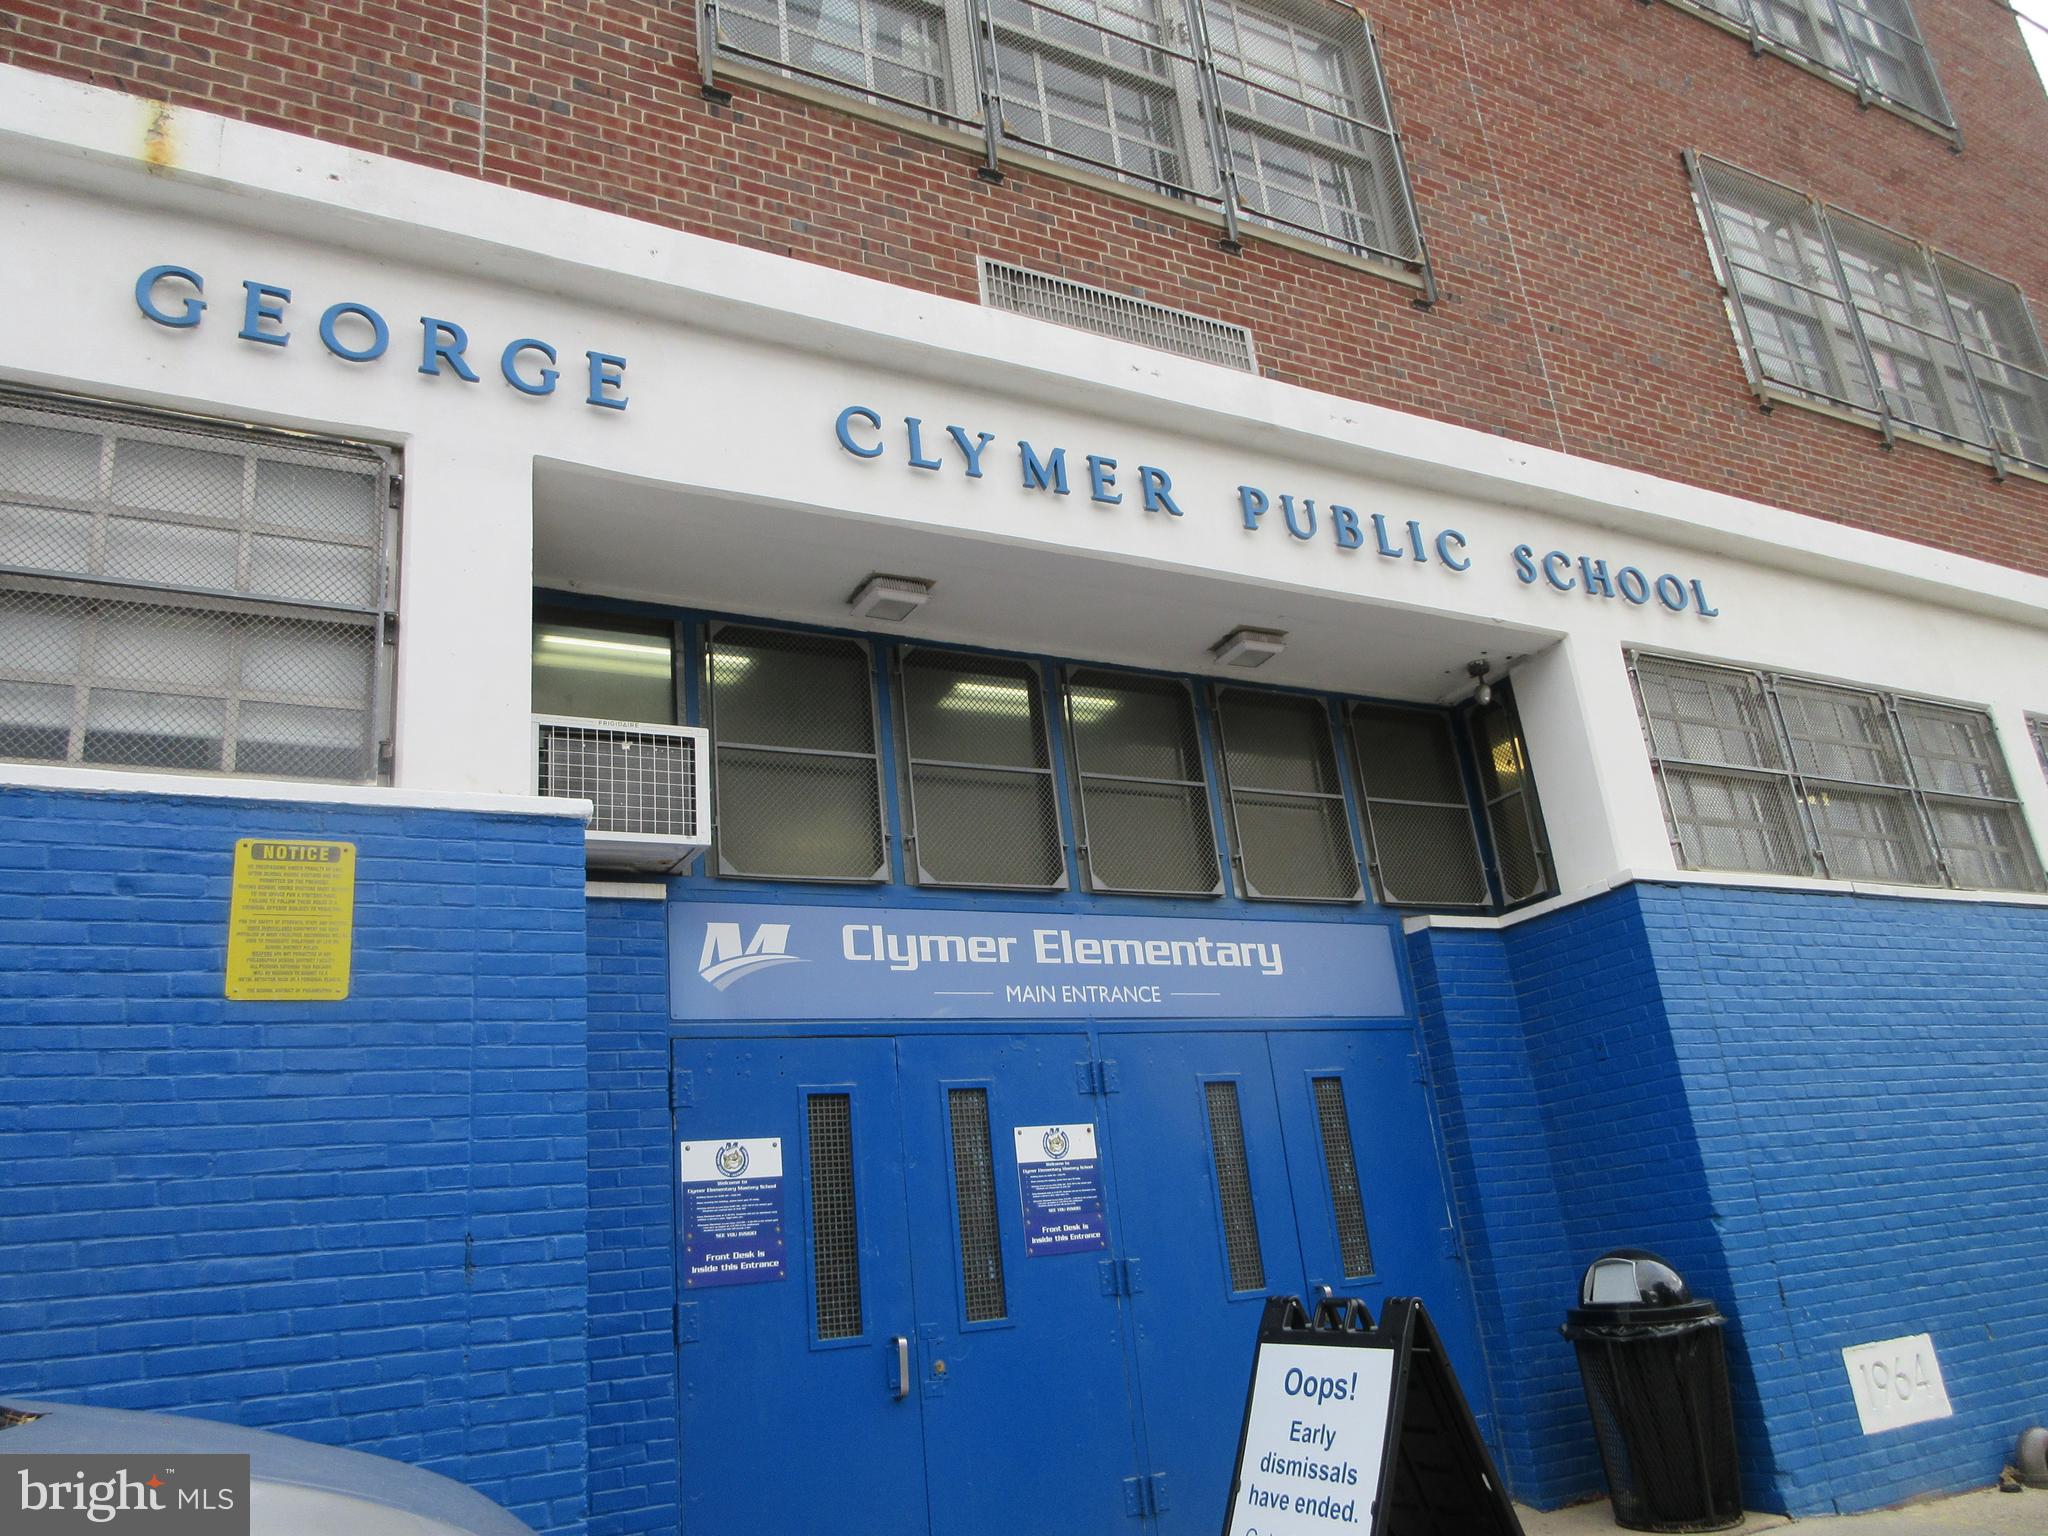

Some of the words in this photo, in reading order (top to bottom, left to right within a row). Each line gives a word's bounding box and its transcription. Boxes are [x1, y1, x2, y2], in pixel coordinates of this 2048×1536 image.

[135, 264, 629, 410] GEORGE
[835, 405, 1184, 517] CLYMER
[1236, 485, 1471, 572] PUBLIC
[1511, 544, 1720, 617] SCHOOL
[598, 720, 640, 729] FRIGIDAIRE
[263, 845, 329, 861] NOTICE
[842, 924, 1017, 971] Clymer
[1033, 929, 1284, 976] Elementary
[1006, 985, 1057, 1003] MAIN
[1062, 986, 1162, 1004] ENTRANCE
[1041, 1225, 1062, 1234] Front
[1063, 1223, 1081, 1232] Desk
[1054, 1234, 1069, 1242] this
[1070, 1231, 1101, 1240] Entrance
[705, 1253, 731, 1262] Front
[732, 1250, 755, 1259] Desk
[721, 1263, 739, 1271] this
[740, 1260, 780, 1270] Entrance
[1283, 1367, 1358, 1406] Oops!
[1857, 1352, 1934, 1411] 1964
[1289, 1420, 1337, 1452] Early
[1260, 1451, 1359, 1486] dismissals
[1248, 1484, 1290, 1511] have
[1295, 1494, 1359, 1524] ended.
